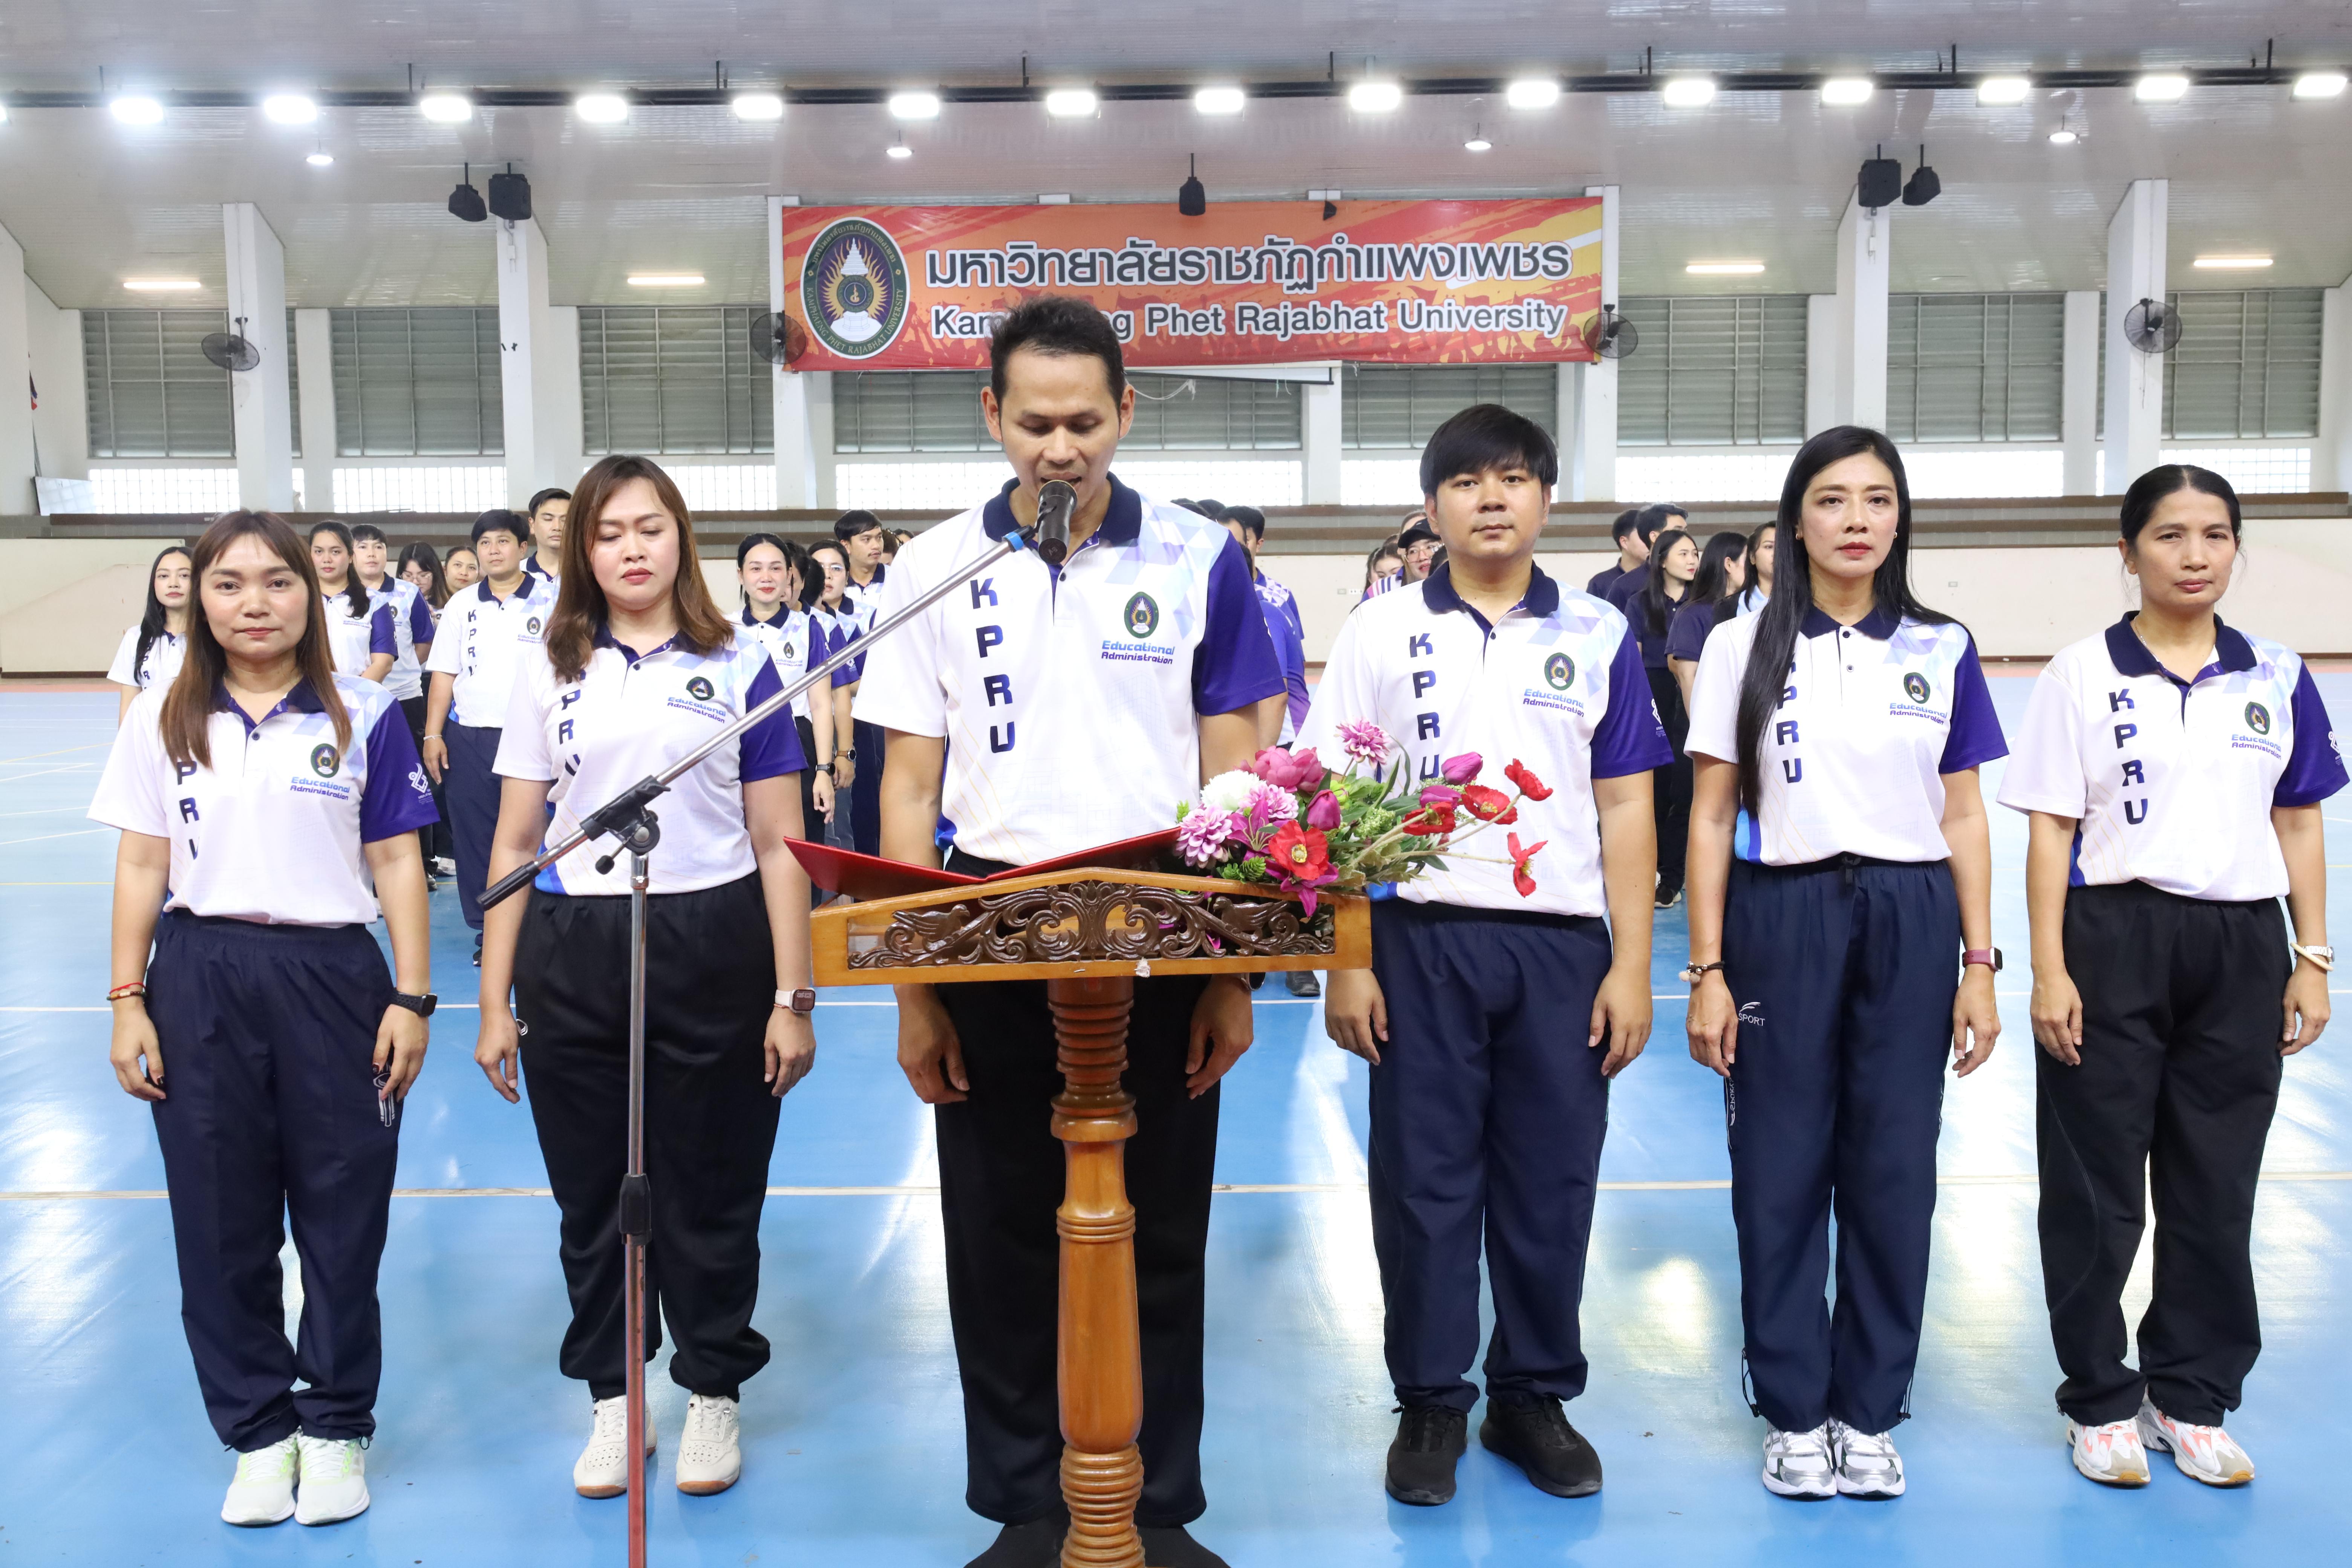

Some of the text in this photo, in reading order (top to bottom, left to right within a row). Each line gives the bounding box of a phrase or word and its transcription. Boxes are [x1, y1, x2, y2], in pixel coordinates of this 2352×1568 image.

[929, 237, 1570, 291] มหาวิทยาลัยราชภัฏกำแพงเพชร
[807, 287, 829, 337] KAMPHAENG
[827, 335, 845, 351] PHET
[848, 335, 887, 355] RAJABHAT
[886, 289, 903, 335] UNIVERSITY
[1148, 306, 1222, 332] Phet
[1239, 304, 1385, 338] Rajabhat
[1401, 300, 1565, 335] University
[1102, 640, 1175, 655] Educational
[970, 577, 1015, 753] KPRU
[1101, 652, 1173, 664] Administration
[667, 702, 725, 723] Administration
[668, 697, 726, 717] Educational
[1523, 698, 1584, 717] Administration
[1890, 703, 1948, 718] Educational
[1776, 662, 1802, 783] PRU
[1890, 710, 1944, 725] Administration
[2231, 734, 2282, 752] Educationa
[2231, 742, 2281, 760] Administration
[2109, 689, 2148, 825] KPRU
[290, 785, 349, 801] Administration
[291, 776, 351, 793] Educational
[1738, 1012, 1766, 1026] SPORT
